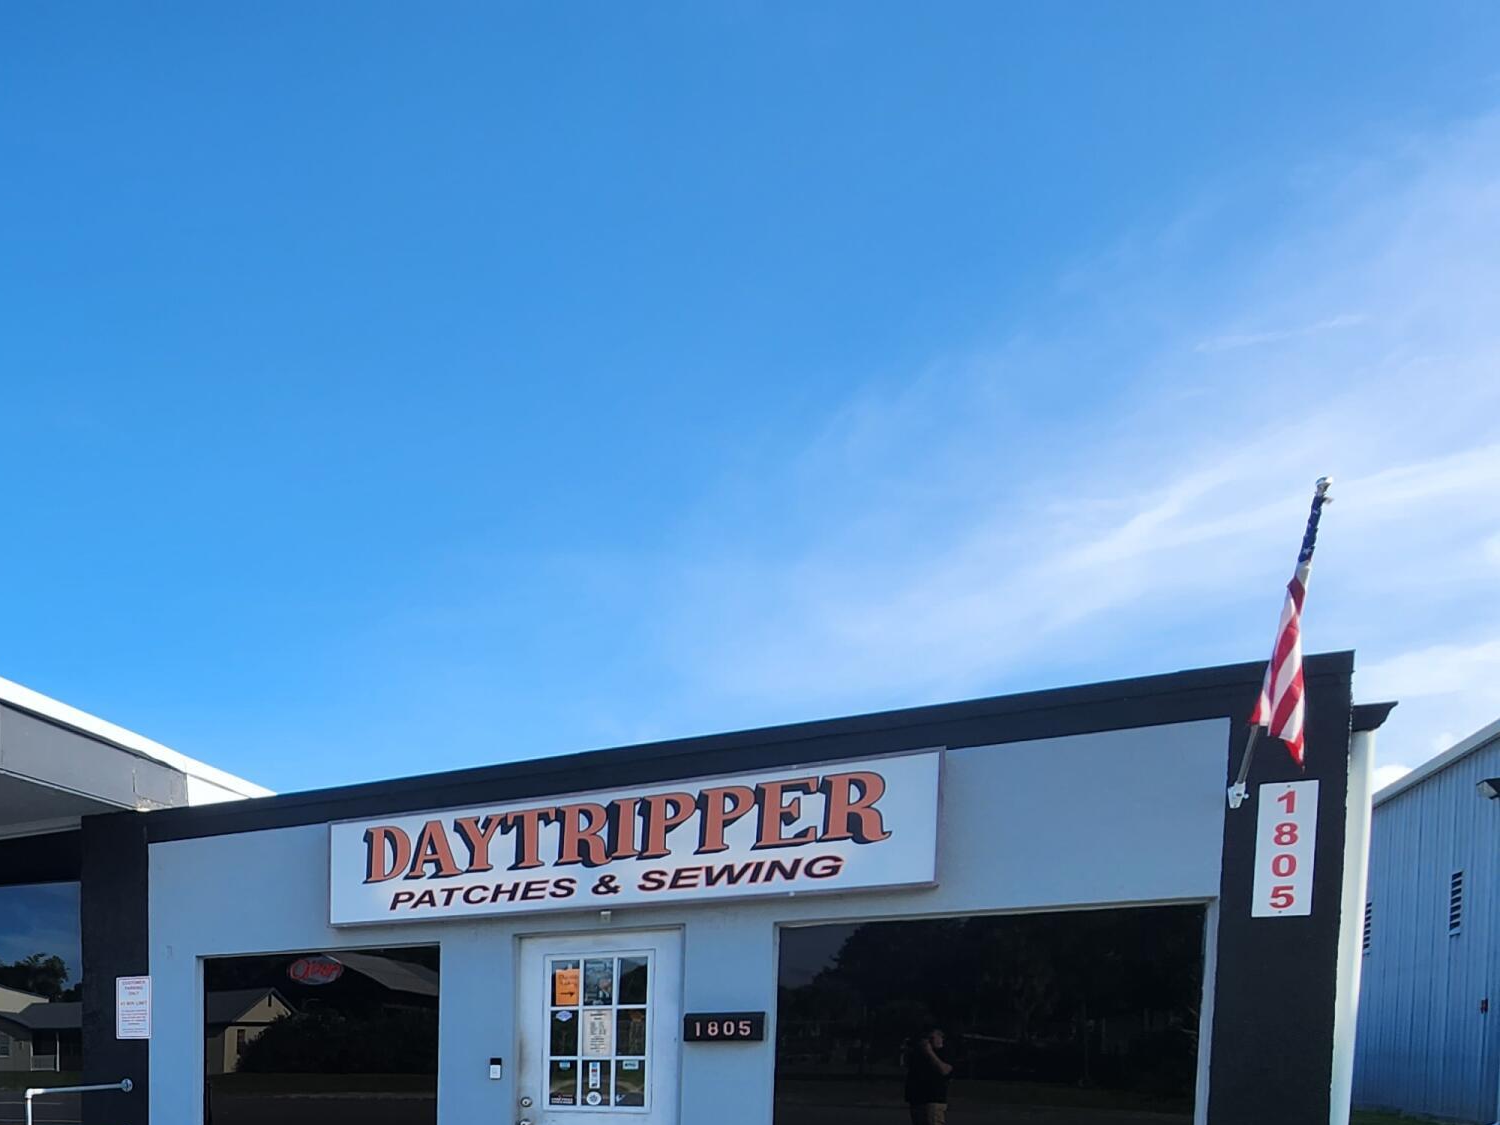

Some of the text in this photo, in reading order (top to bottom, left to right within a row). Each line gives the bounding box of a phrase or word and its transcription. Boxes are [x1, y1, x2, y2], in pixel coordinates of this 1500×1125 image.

[363, 771, 892, 884] DAYTRIPPER
[1269, 790, 1299, 909] 1805
[389, 855, 845, 911] PATCHES & SEWING
[695, 1020, 752, 1037] 1805
